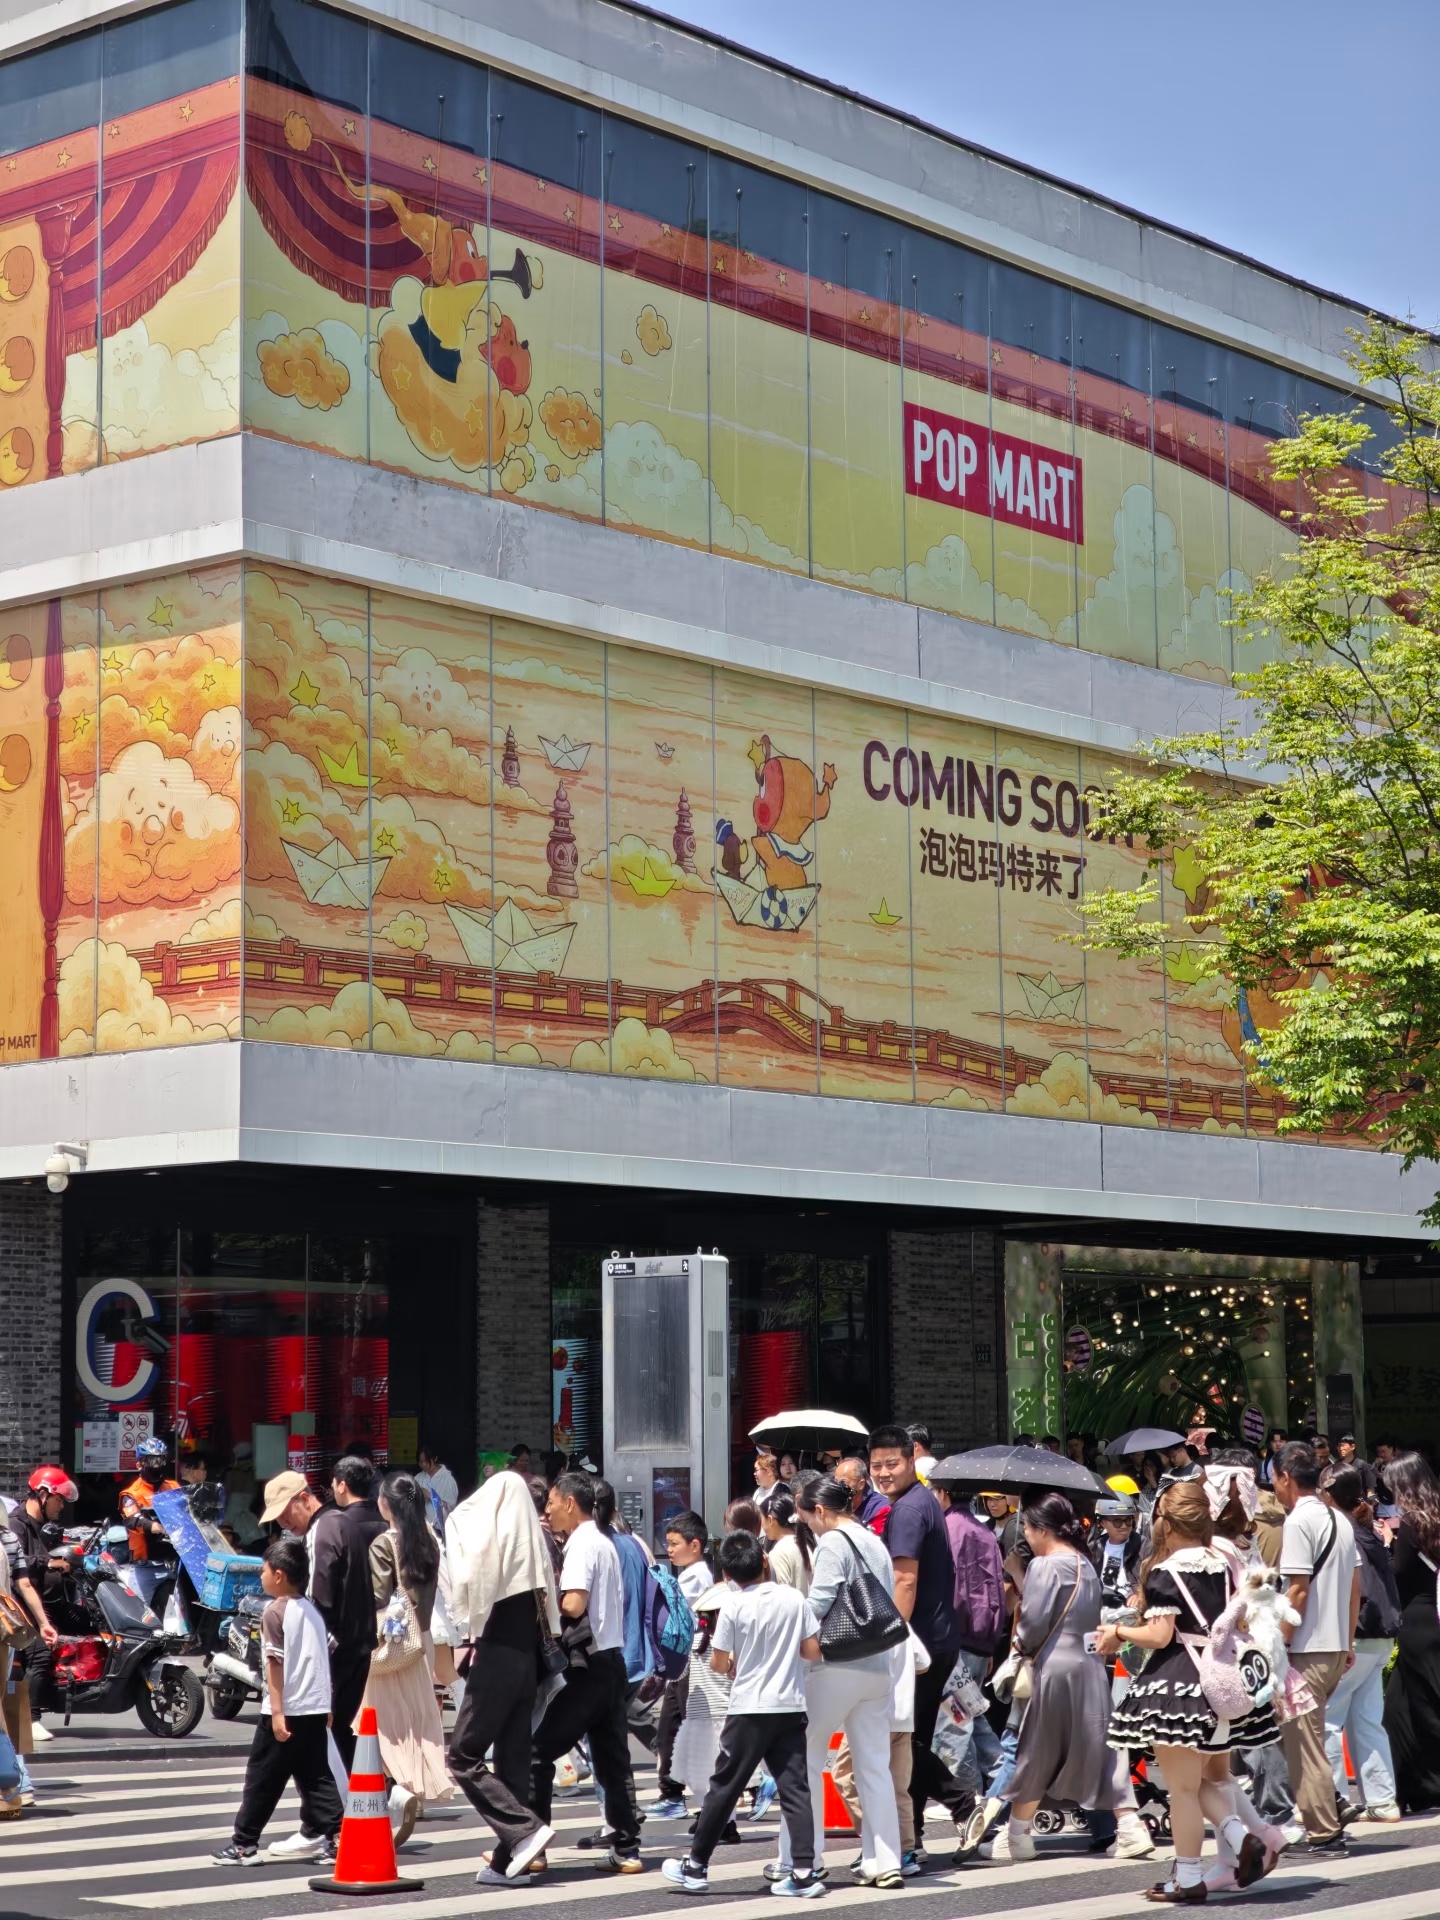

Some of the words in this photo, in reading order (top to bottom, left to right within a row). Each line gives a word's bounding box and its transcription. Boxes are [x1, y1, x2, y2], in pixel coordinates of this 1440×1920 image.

[913, 420, 978, 497] POP
[988, 442, 1075, 529] MART
[863, 740, 1022, 827] COMING
[919, 827, 1088, 900] 泡泡玛特来了
[7, 1034, 38, 1051] MART
